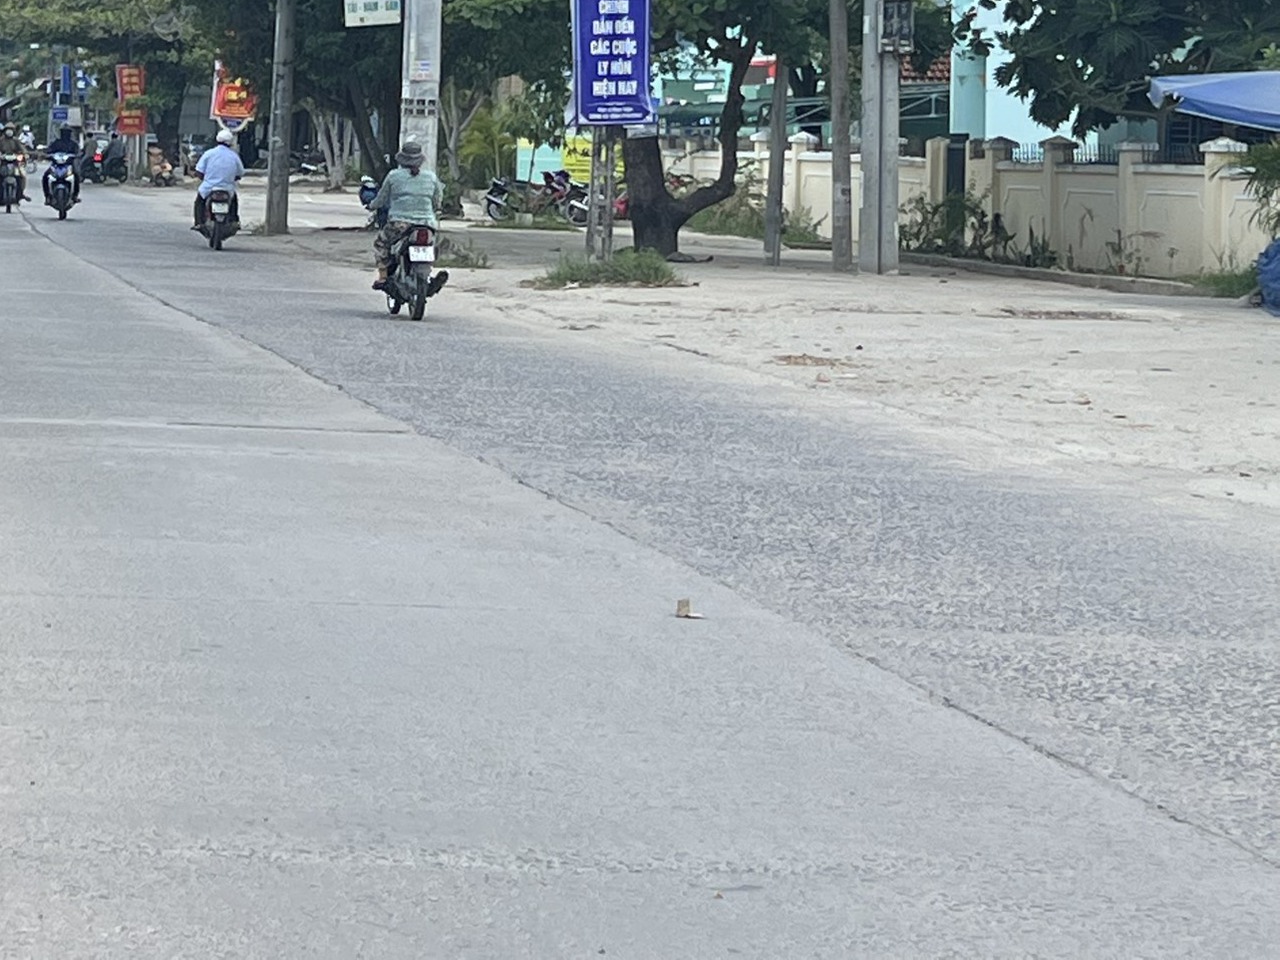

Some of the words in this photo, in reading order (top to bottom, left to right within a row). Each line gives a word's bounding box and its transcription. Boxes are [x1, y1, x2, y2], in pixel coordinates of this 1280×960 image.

[590, 38, 610, 55] CÁC
[612, 38, 637, 58] CUỘC
[598, 61, 609, 76] LY
[610, 58, 632, 75] HÔN
[592, 78, 617, 99] HIỆN
[618, 80, 638, 96] NAY
